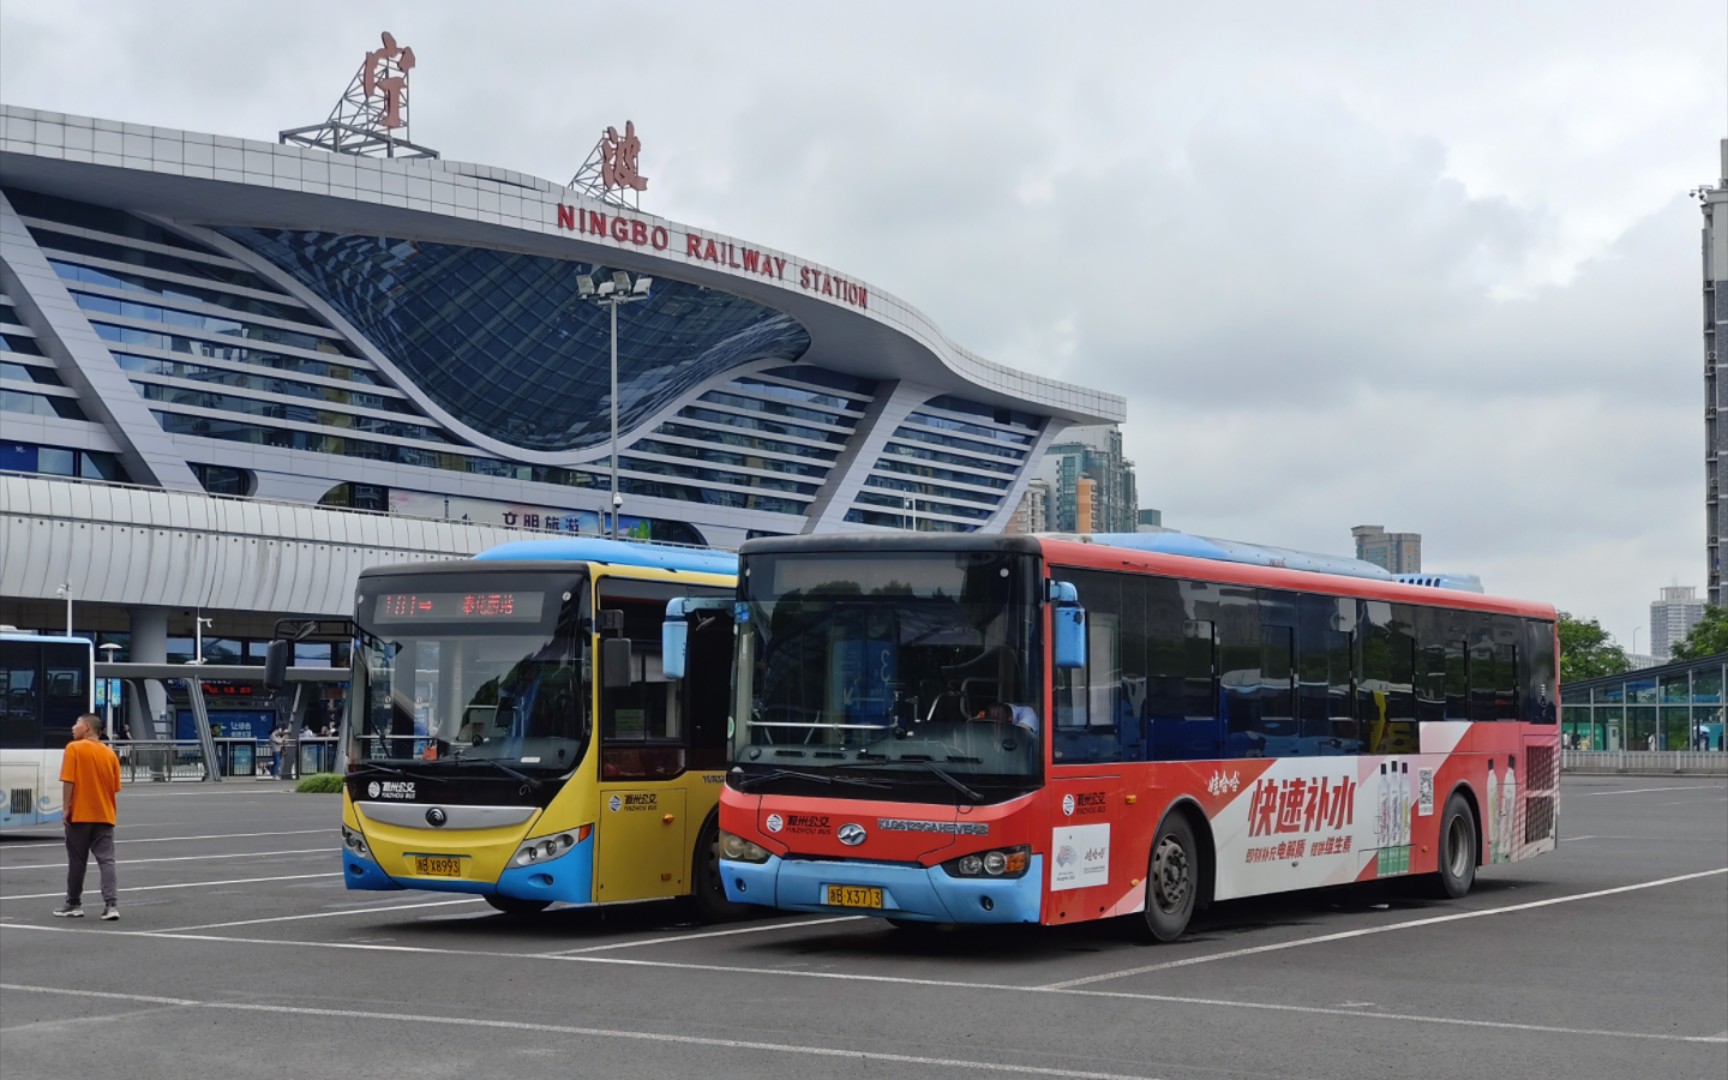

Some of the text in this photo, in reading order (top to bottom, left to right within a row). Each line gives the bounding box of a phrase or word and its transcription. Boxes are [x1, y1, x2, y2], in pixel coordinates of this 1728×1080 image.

[556, 202, 868, 310] NINGBO RAILWAY STATION
[1247, 775, 1357, 838] 快速补水
